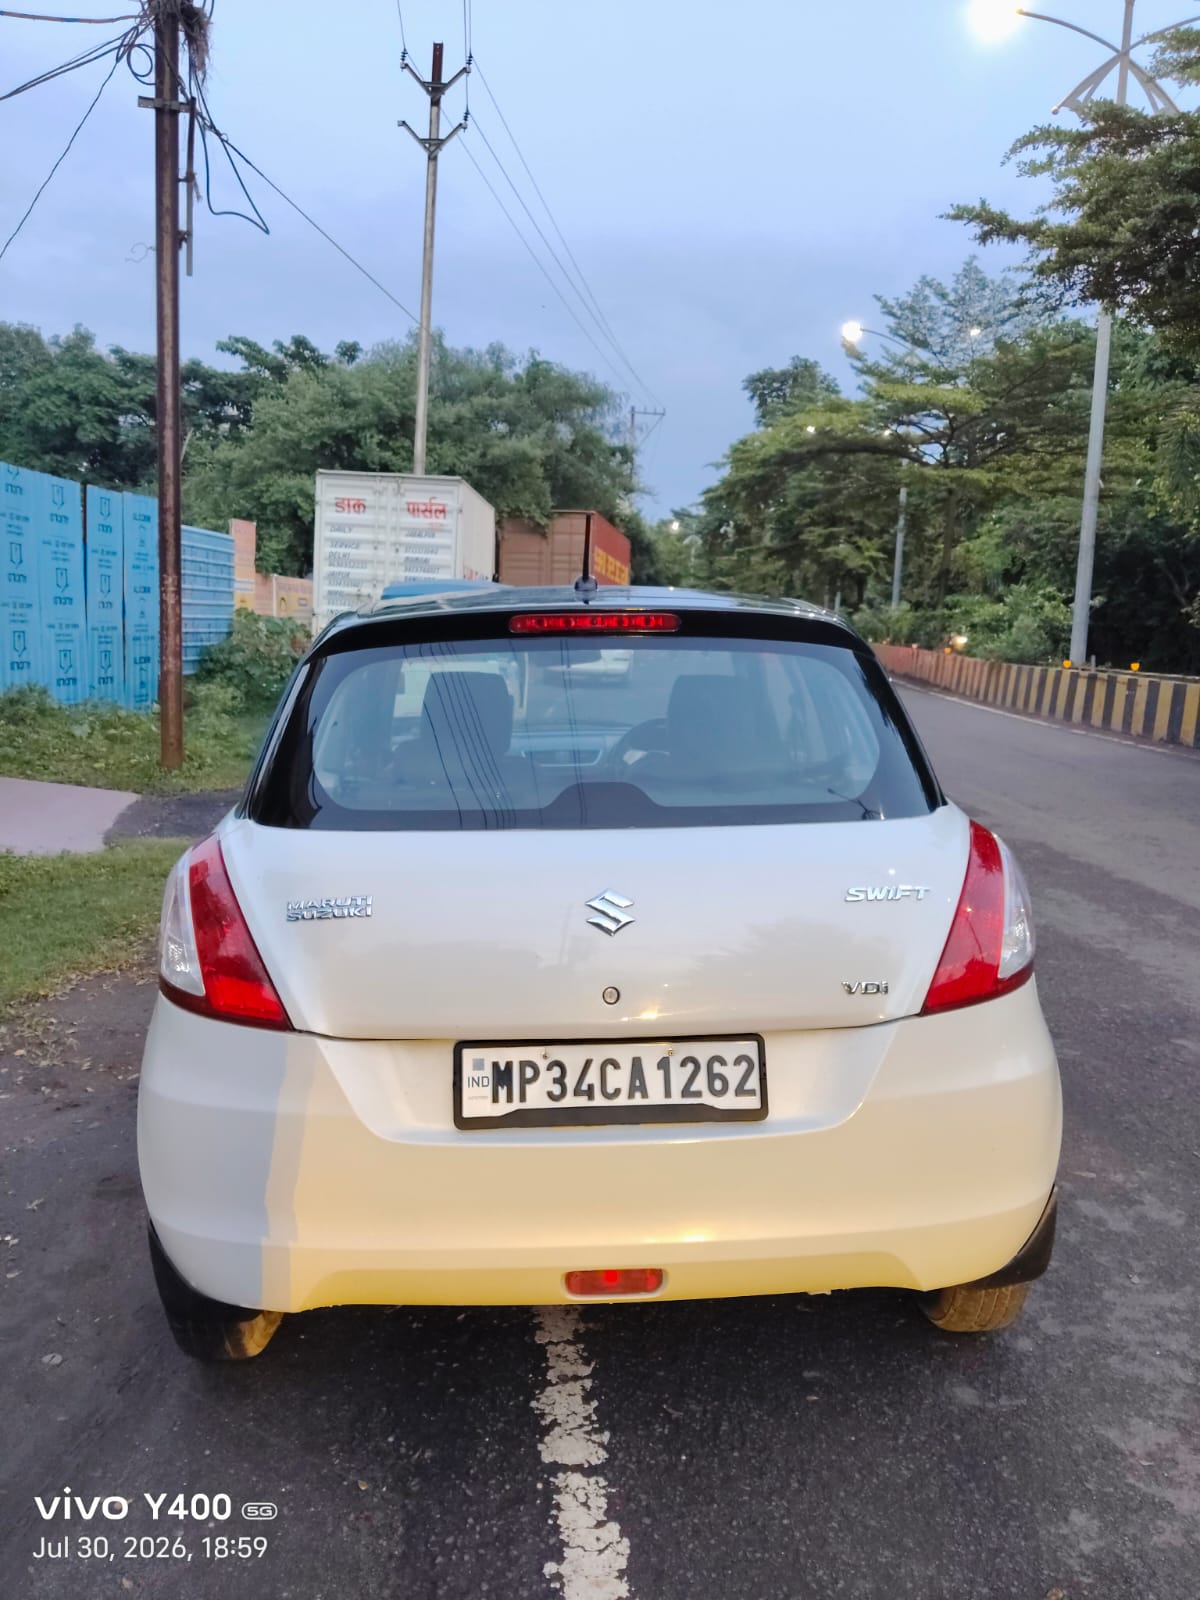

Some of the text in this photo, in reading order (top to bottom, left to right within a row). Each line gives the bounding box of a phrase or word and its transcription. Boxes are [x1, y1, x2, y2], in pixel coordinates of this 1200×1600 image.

[334, 496, 448, 520] डाक पार्सल
[328, 551, 351, 560] DELHI
[844, 884, 931, 902] SWIFT
[287, 895, 373, 910] MARUTI
[286, 905, 373, 921] SUZUKI
[842, 980, 889, 995] VDi
[467, 1075, 490, 1089] IND
[491, 1054, 757, 1105] MP34CA1262
